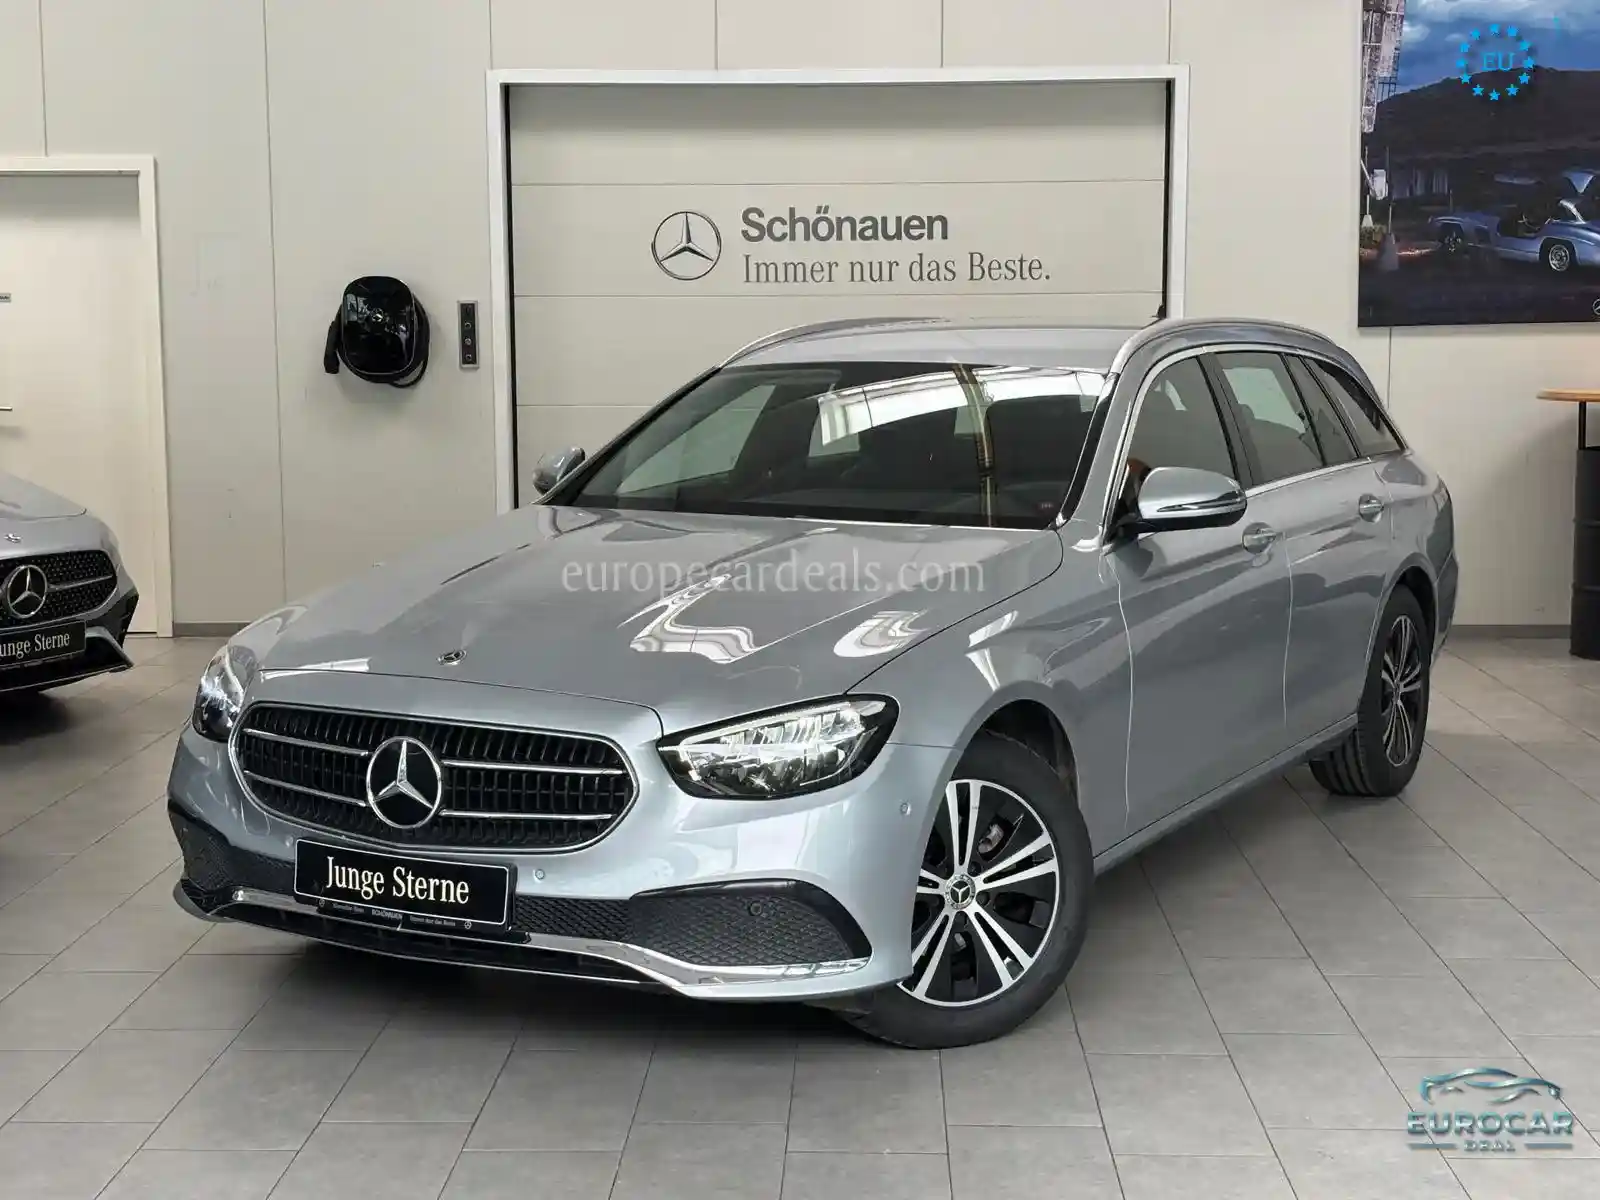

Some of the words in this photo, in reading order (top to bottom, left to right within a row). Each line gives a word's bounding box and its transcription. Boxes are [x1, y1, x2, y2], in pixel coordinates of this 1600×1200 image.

[740, 205, 949, 243] Schönauen
[742, 254, 839, 284] Immer
[849, 257, 899, 283] nur
[908, 252, 957, 283] das
[967, 251, 1052, 282] Beste.
[0, 639, 31, 660] unge
[34, 633, 70, 652] Sterne
[326, 855, 385, 900] Junge
[392, 866, 470, 904] Sterne
